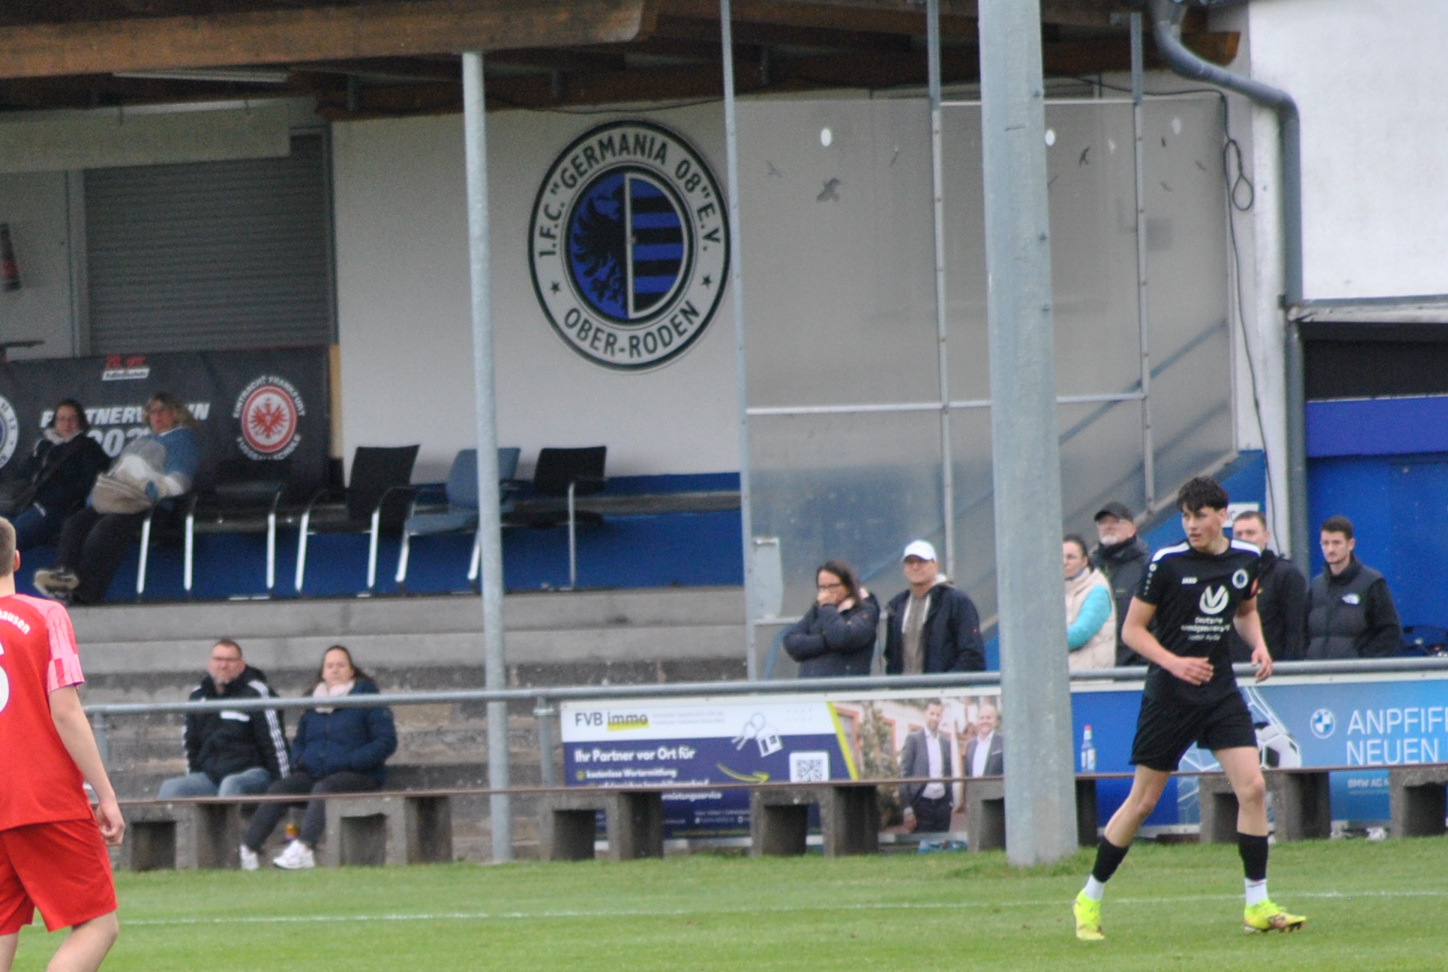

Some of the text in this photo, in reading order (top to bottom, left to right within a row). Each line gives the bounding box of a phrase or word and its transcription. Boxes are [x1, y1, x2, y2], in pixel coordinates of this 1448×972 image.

[696, 203, 722, 252] E.V.
[563, 300, 700, 358] OBER-RODEN
[574, 711, 603, 727] FVB
[607, 711, 649, 727] immo
[574, 745, 696, 763] Ihr Partner vor Ort für
[1346, 738, 1439, 766] NEUEN
